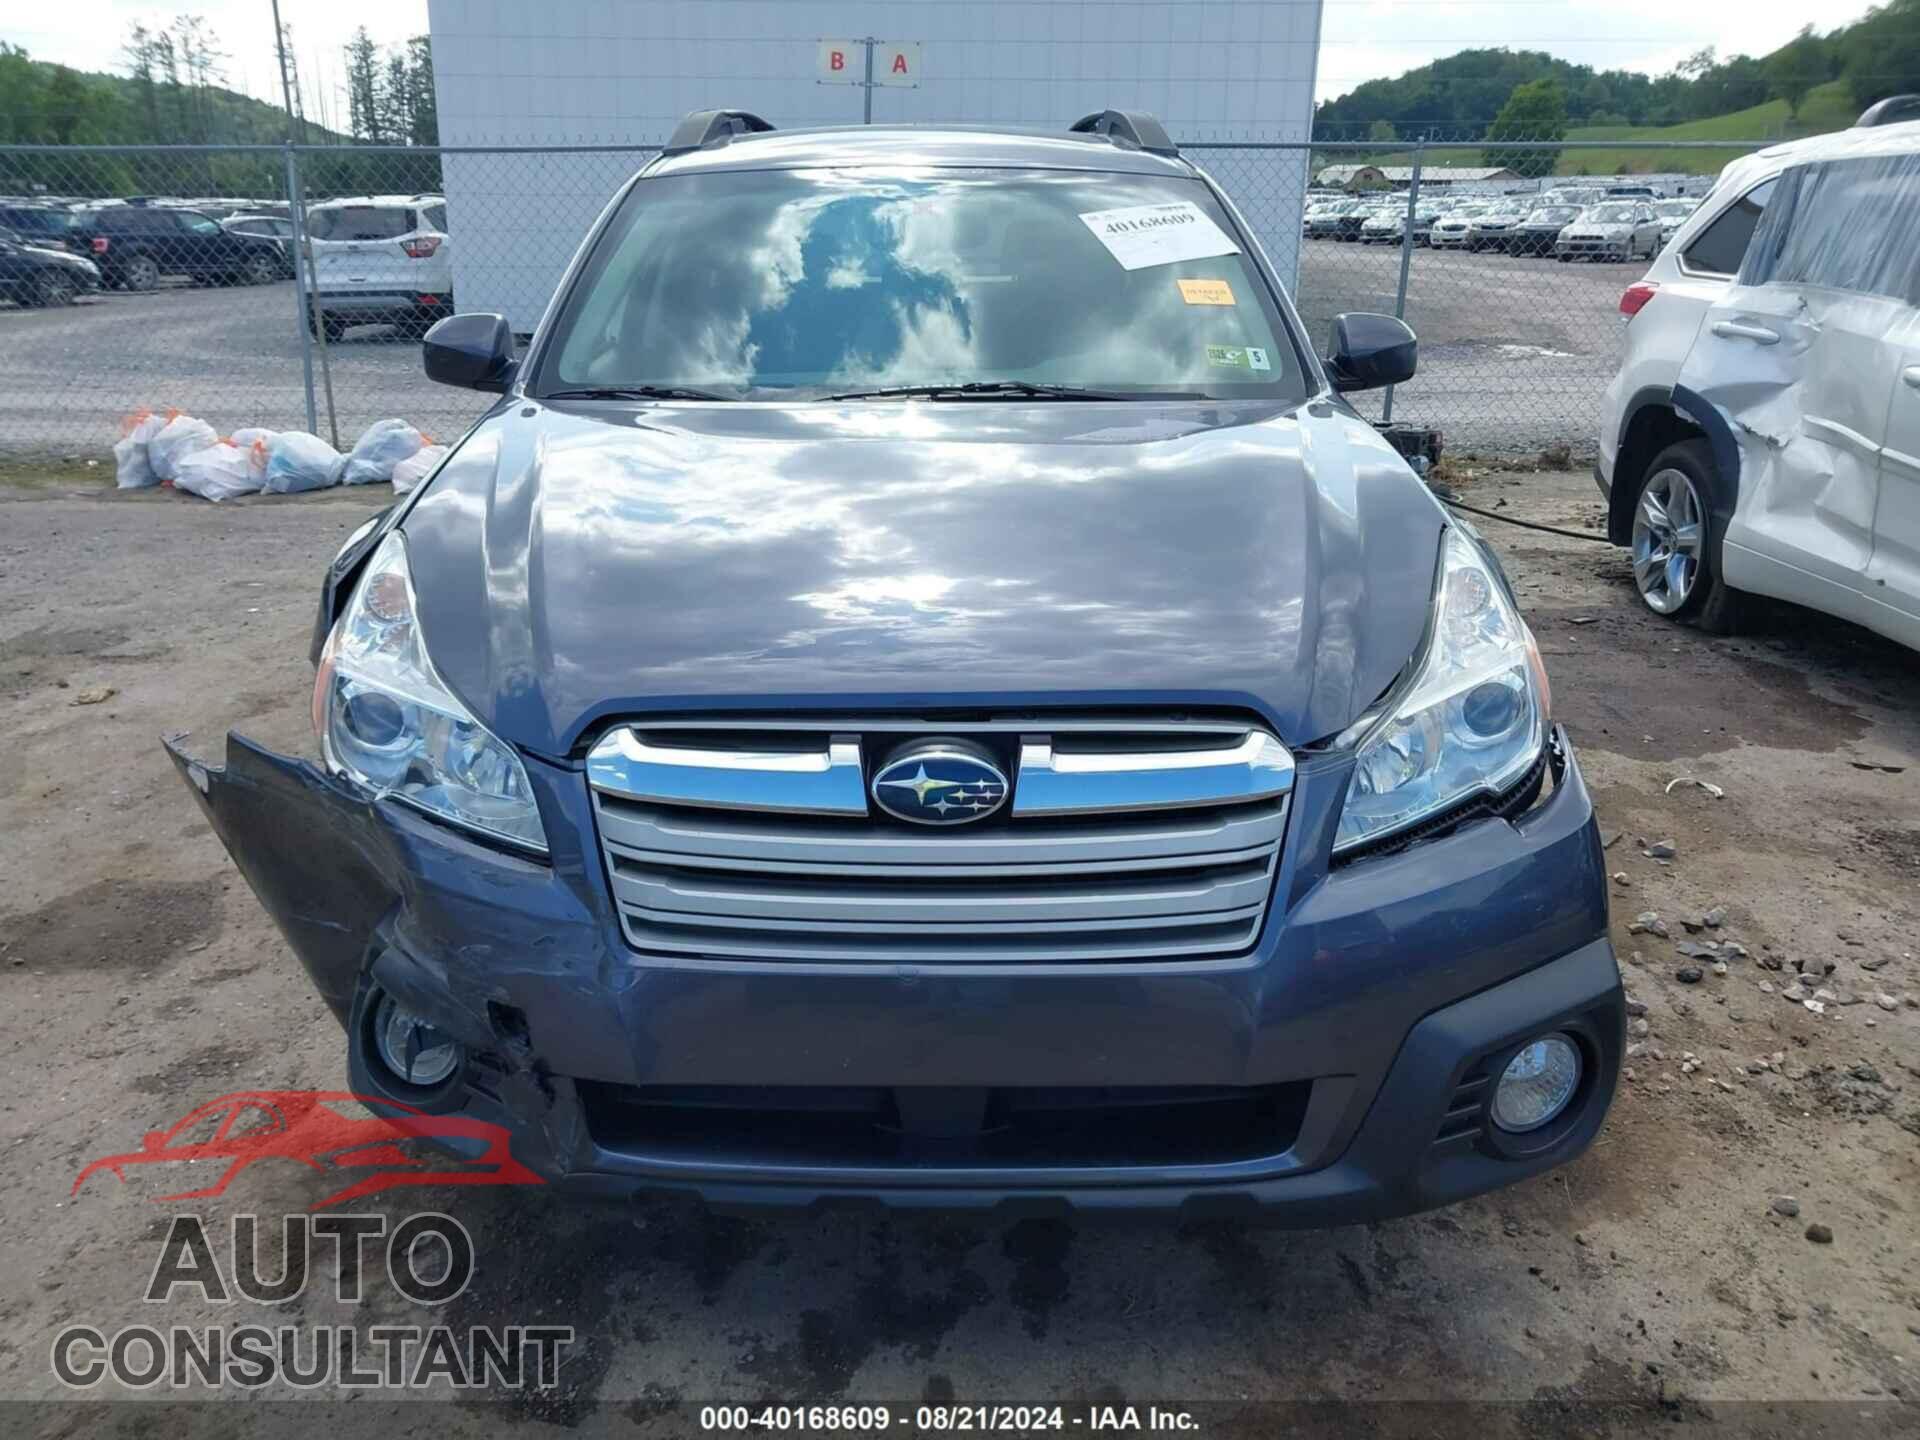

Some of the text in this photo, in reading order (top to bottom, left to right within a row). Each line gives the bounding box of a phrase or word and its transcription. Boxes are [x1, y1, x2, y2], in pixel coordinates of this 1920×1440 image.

[831, 51, 844, 71] B
[892, 53, 907, 74] A
[1105, 212, 1196, 234] 40168609
